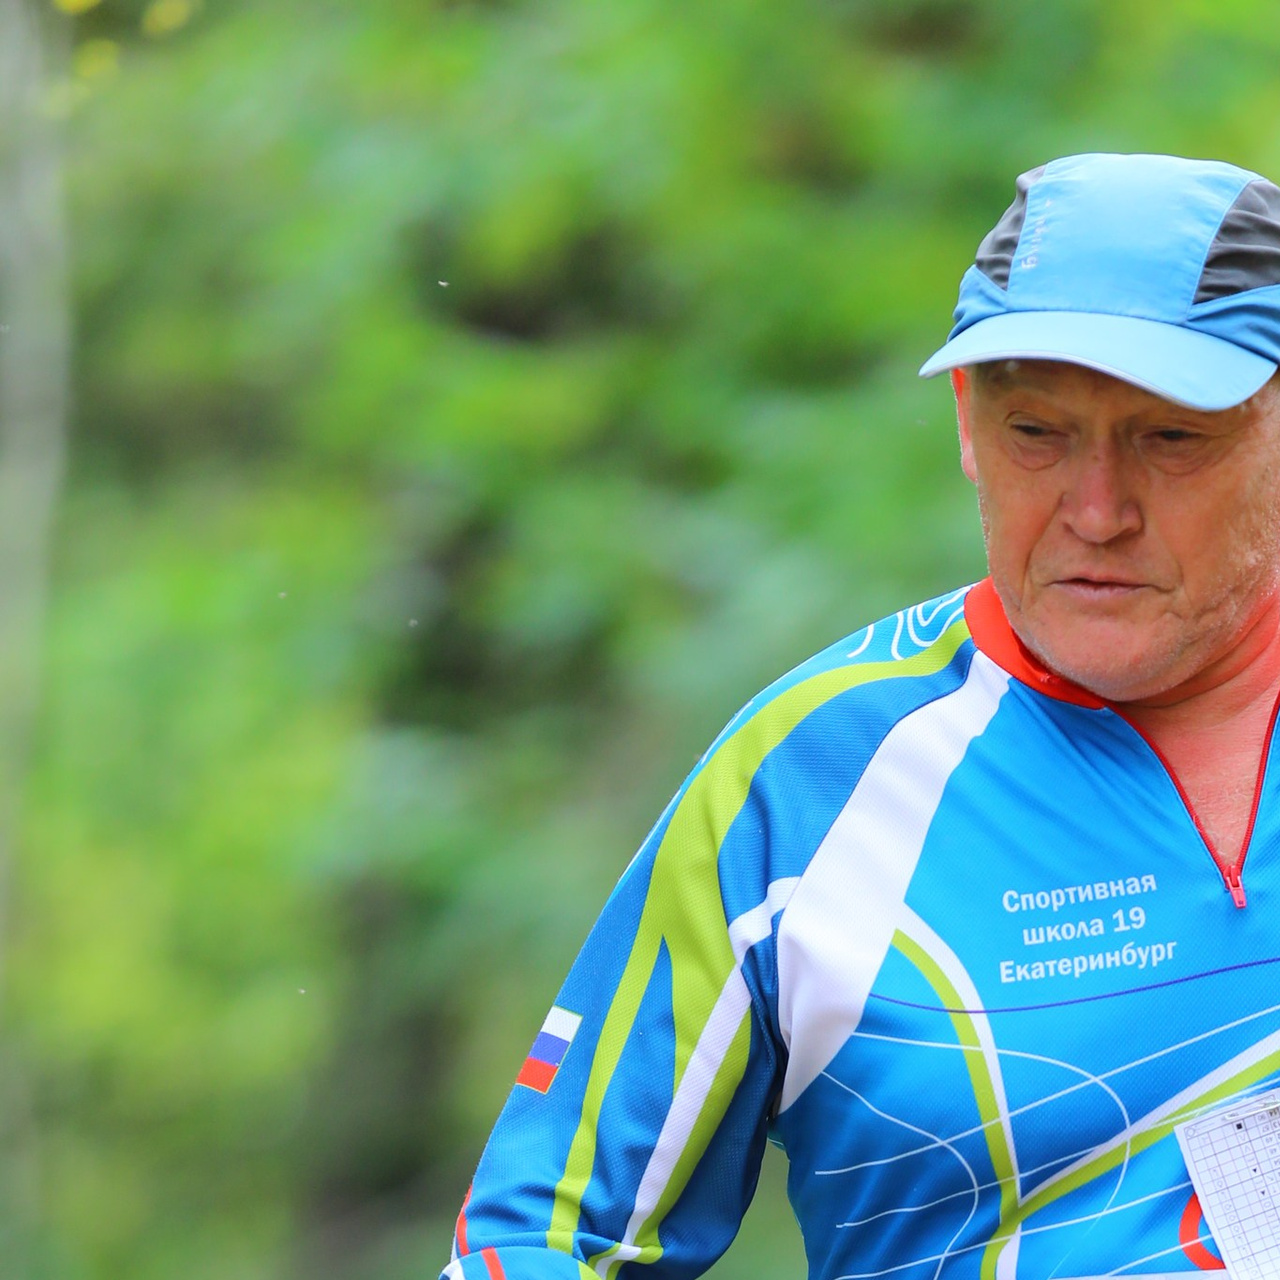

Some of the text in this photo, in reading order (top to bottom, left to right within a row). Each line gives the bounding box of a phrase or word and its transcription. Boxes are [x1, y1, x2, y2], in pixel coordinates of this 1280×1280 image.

[1002, 873, 1158, 913] Спортивная
[1022, 906, 1147, 946] школа 19
[999, 941, 1177, 984] Екатеринбург
